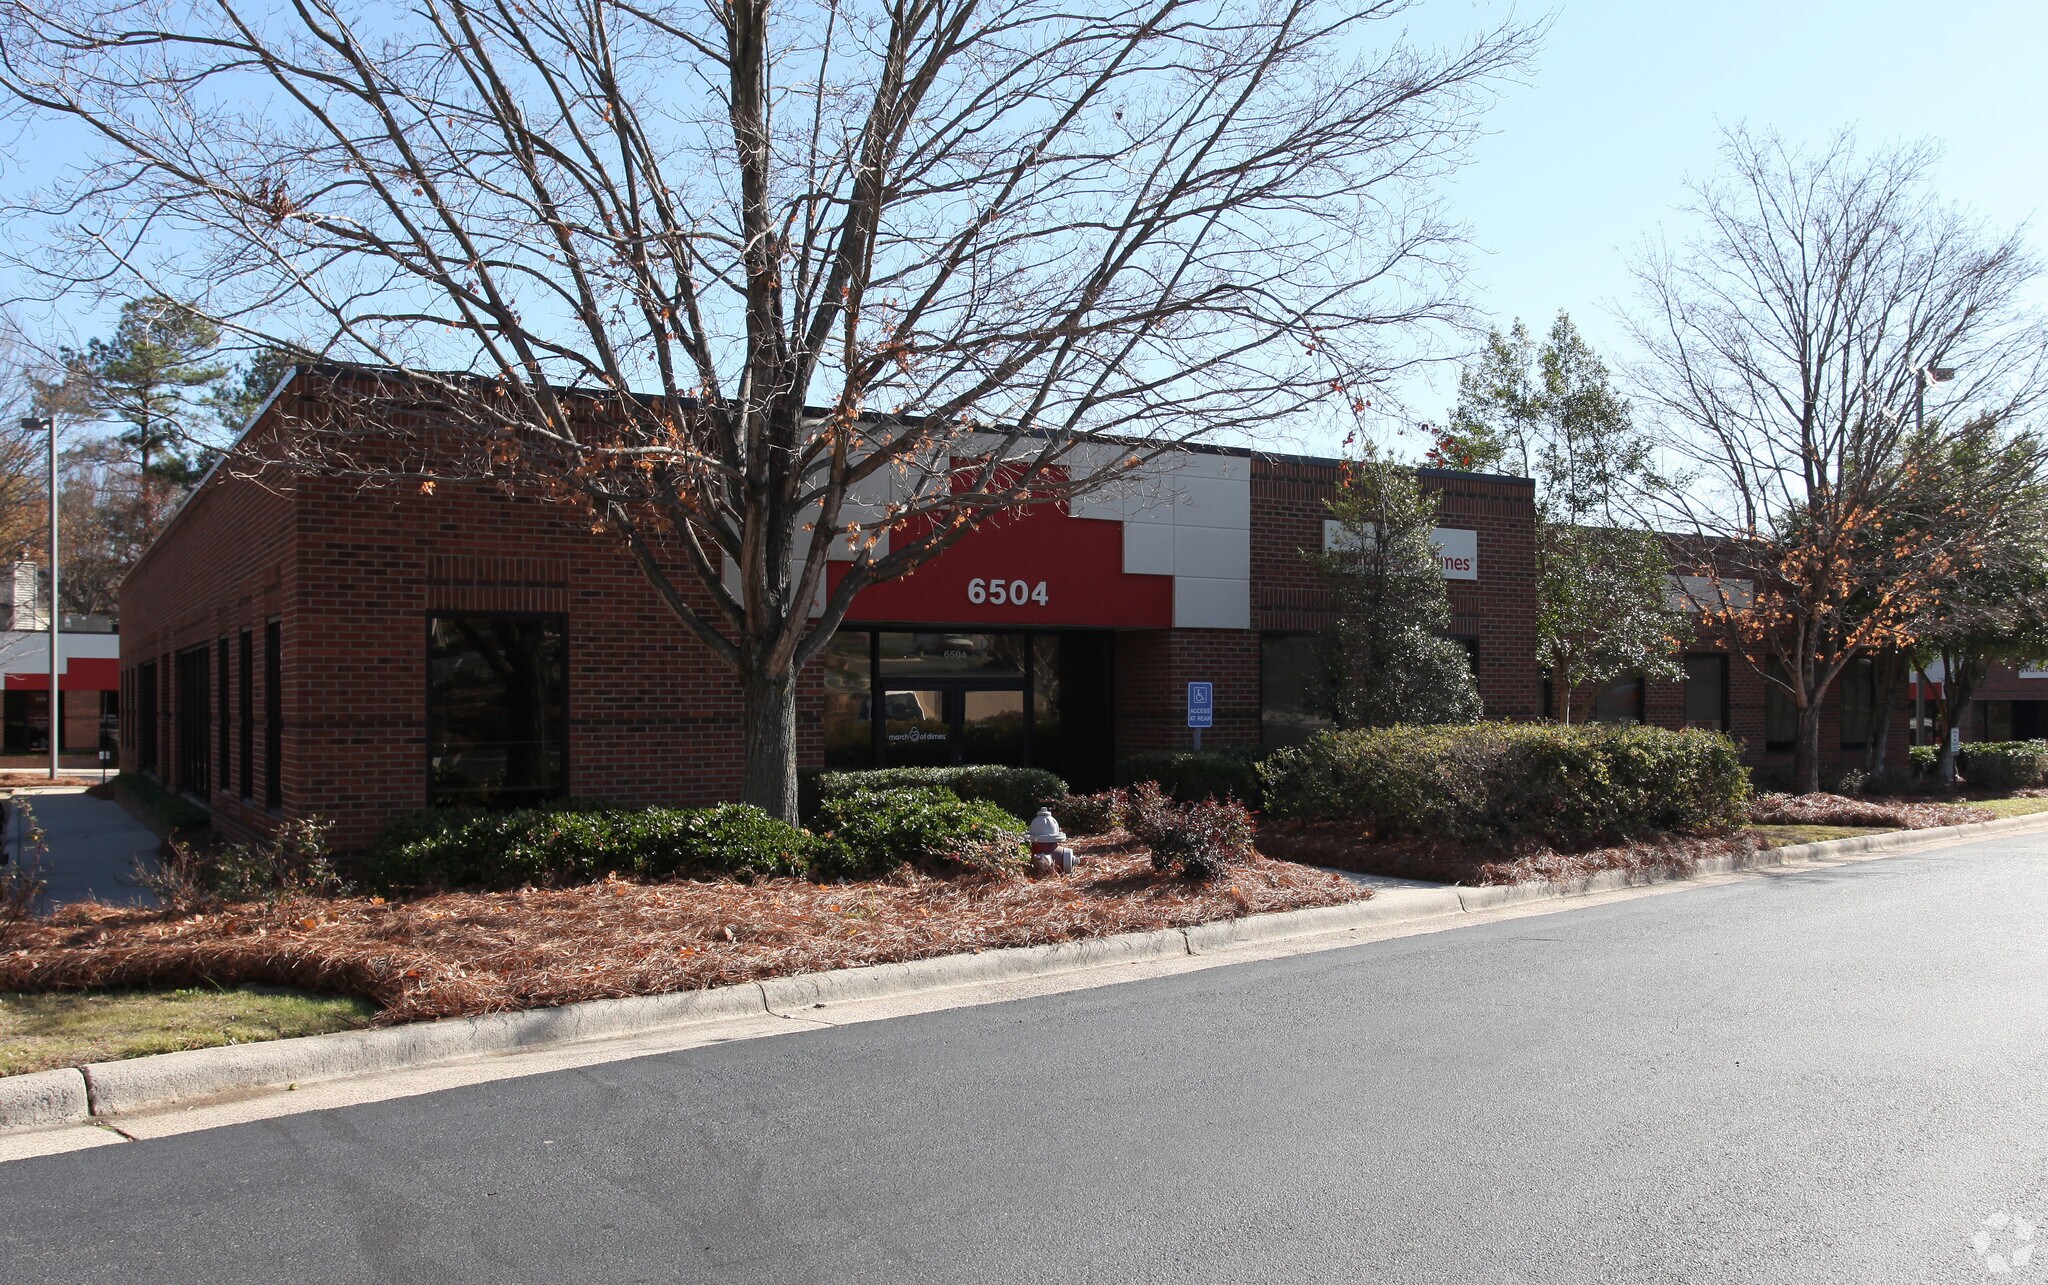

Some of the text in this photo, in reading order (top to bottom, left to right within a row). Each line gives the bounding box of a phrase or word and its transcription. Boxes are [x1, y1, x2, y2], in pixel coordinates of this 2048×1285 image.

[967, 577, 1049, 606] 6504
[943, 650, 967, 659] 6504
[920, 732, 927, 740] of
[927, 732, 946, 740] dimes
